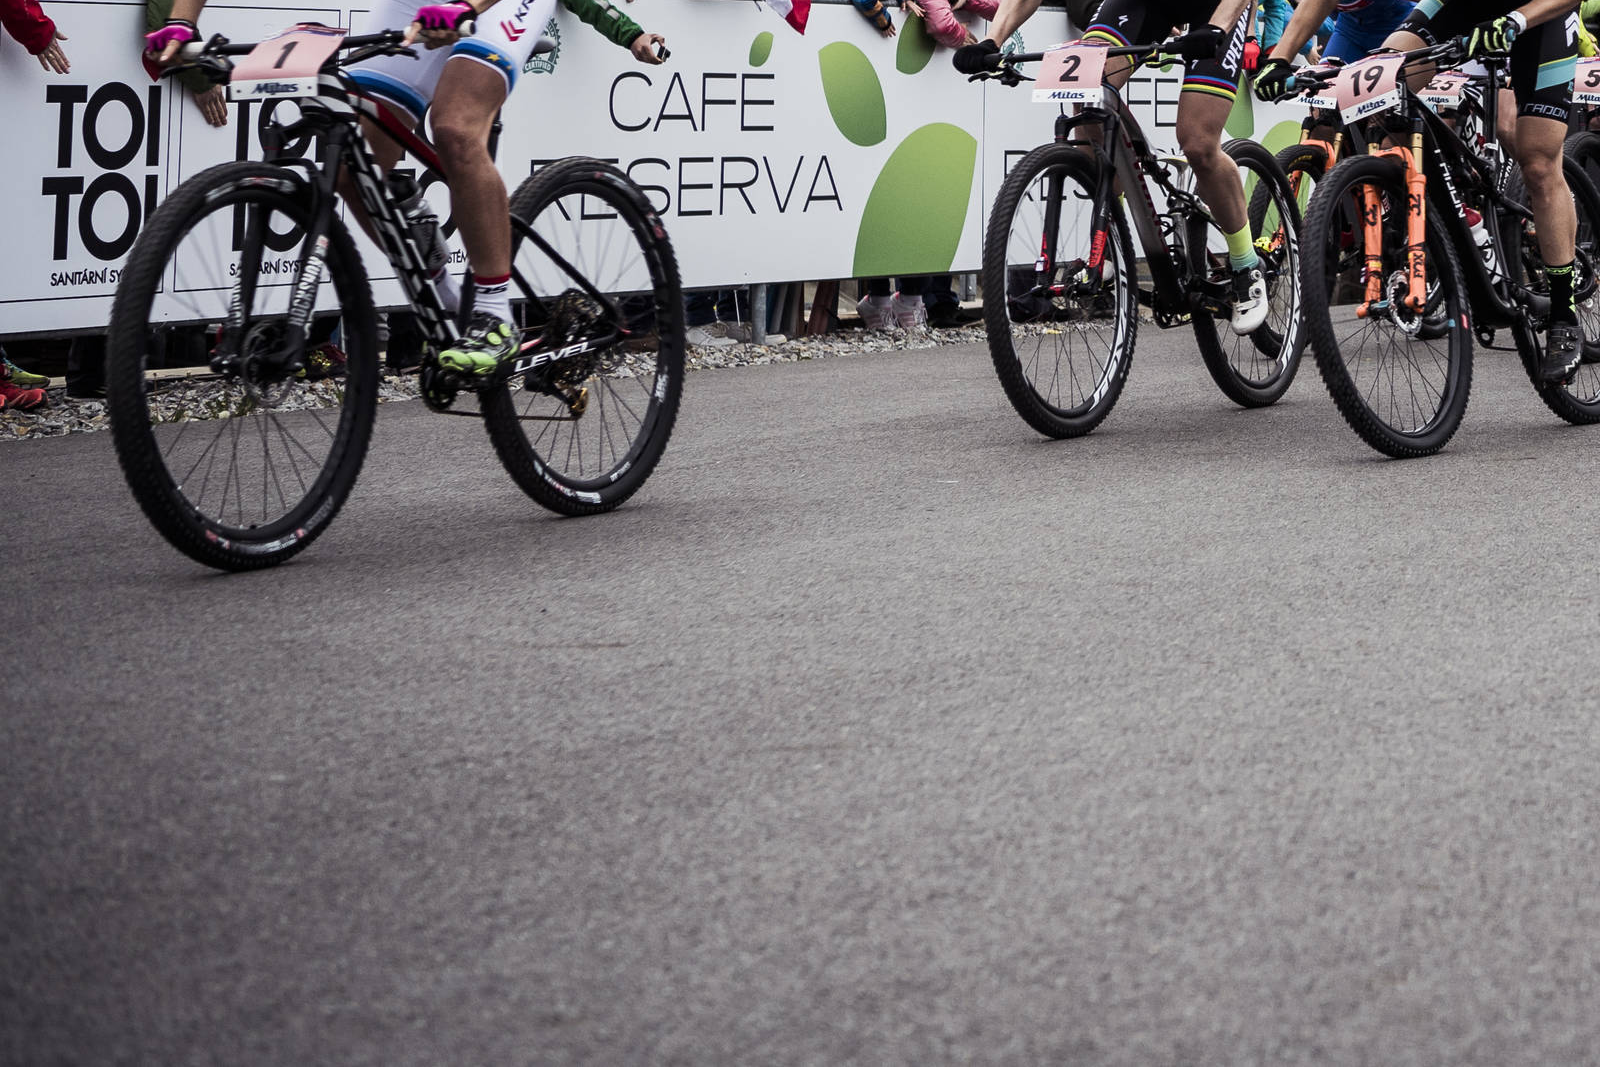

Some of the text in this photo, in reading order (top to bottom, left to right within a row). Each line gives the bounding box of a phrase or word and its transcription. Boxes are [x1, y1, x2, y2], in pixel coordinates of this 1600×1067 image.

[273, 41, 298, 69] 1
[1059, 55, 1081, 82] 2
[1350, 65, 1384, 97] 19
[1048, 91, 1085, 100] Mitas
[1356, 97, 1387, 116] Mitas
[46, 81, 162, 170] TOI
[514, 340, 597, 374] LEVEL
